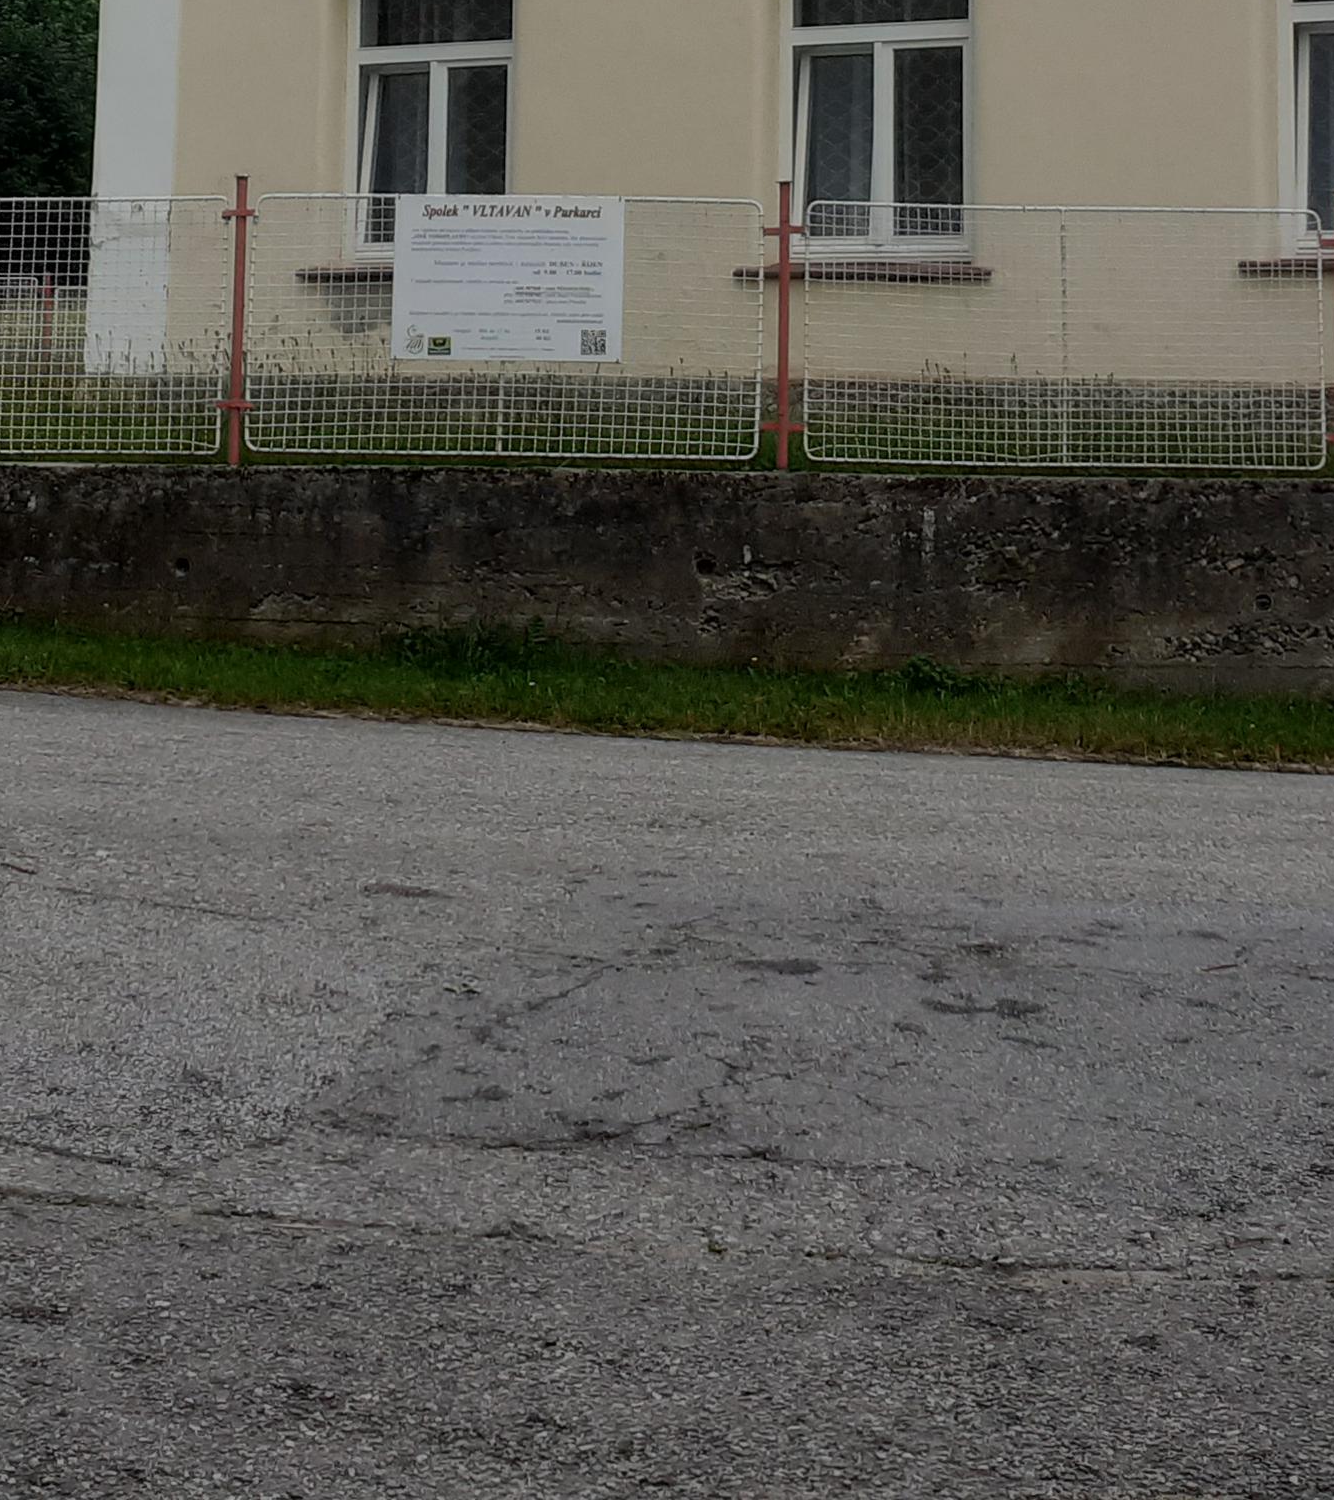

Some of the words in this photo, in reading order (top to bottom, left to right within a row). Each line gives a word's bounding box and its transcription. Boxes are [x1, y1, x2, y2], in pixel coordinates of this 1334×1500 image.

[422, 204, 459, 219] Spolek
[471, 204, 532, 218] VLTAVAN
[544, 208, 551, 217] v
[553, 205, 602, 219] Purkarci
